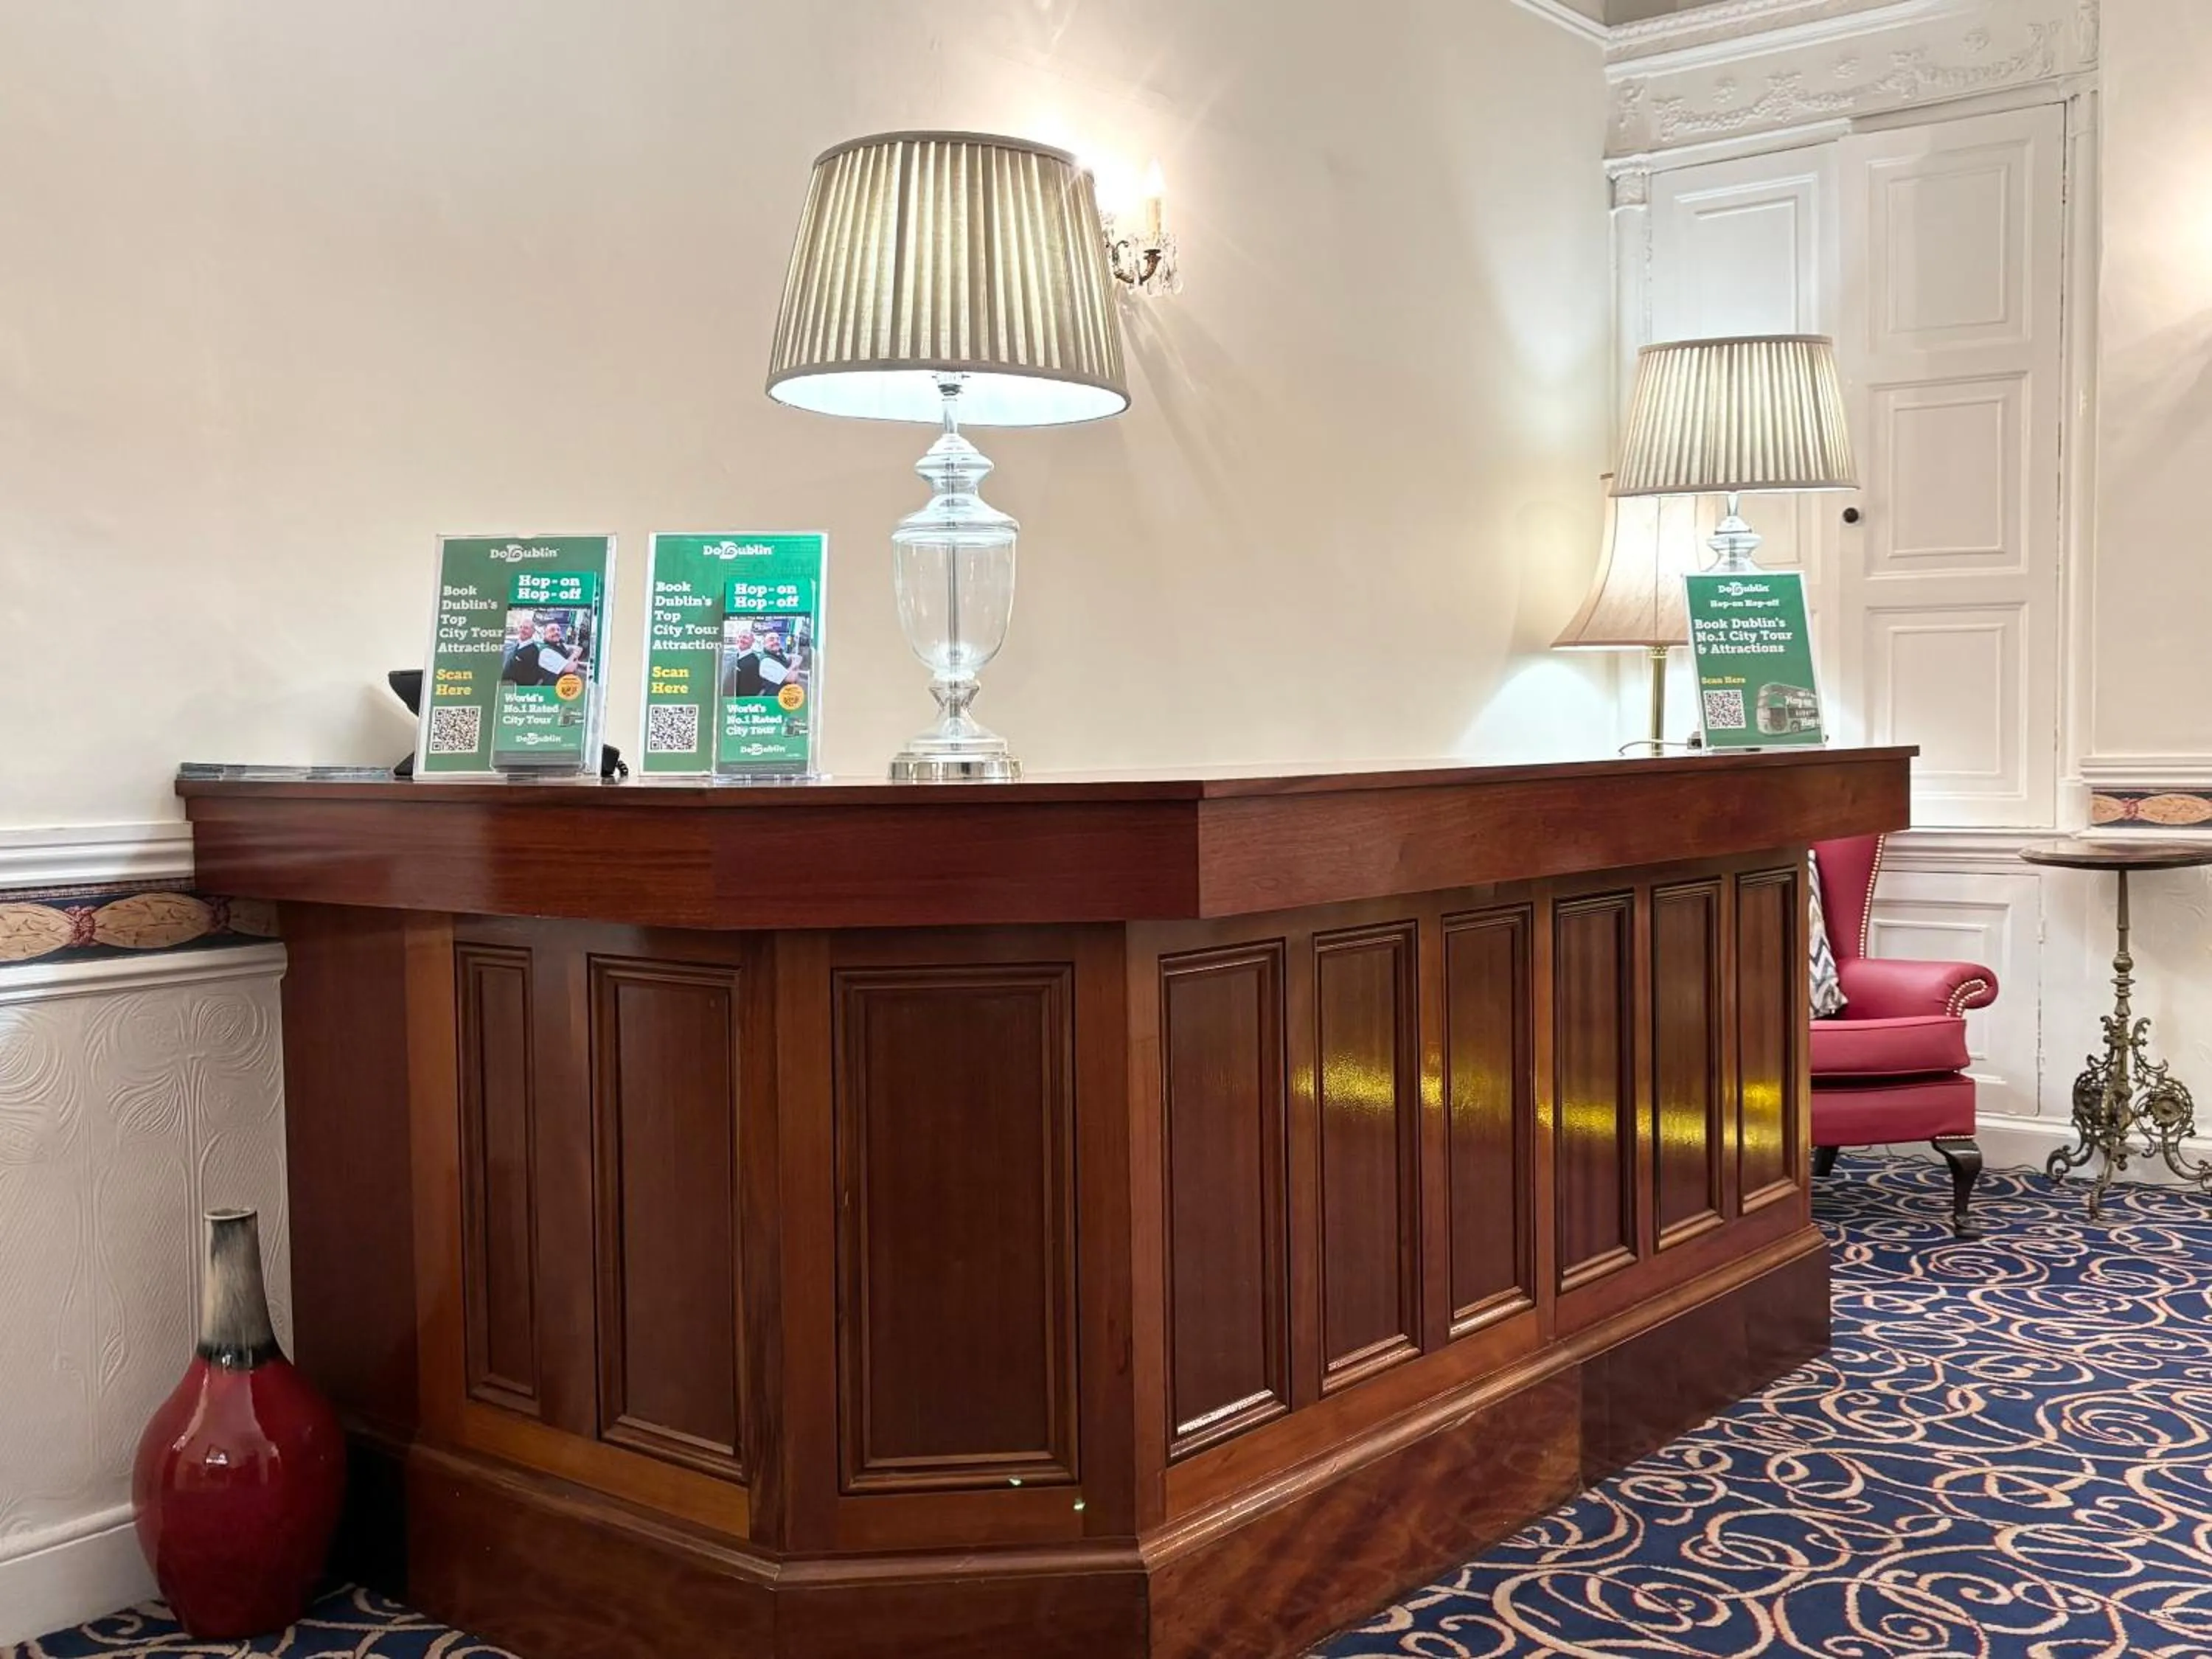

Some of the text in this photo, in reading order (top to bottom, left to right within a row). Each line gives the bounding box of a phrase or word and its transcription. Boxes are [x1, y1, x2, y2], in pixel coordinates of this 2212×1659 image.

[443, 585, 477, 597] Book
[655, 582, 692, 592] Book
[442, 599, 498, 611] Dublin's
[654, 596, 712, 607] Dublin's
[440, 615, 467, 627] Top
[654, 611, 681, 622] Top
[1694, 617, 1786, 629] Book Dublin's
[439, 626, 504, 640] City Tour
[653, 625, 719, 637] City Tour
[1696, 630, 1793, 643] No.1 City Tour
[1711, 643, 1785, 654] Attractions
[436, 669, 473, 681] Scan
[652, 667, 689, 678] Scan
[1701, 675, 1746, 685] Scan Here
[436, 684, 472, 695] Here
[651, 682, 689, 694] Here
[504, 692, 544, 703] World's
[503, 704, 527, 713] No.1
[529, 703, 560, 713] Rated
[726, 703, 766, 714] World's
[502, 714, 552, 726] City Tour
[726, 714, 782, 725] No.1 Rated
[726, 724, 776, 737] City Tour
